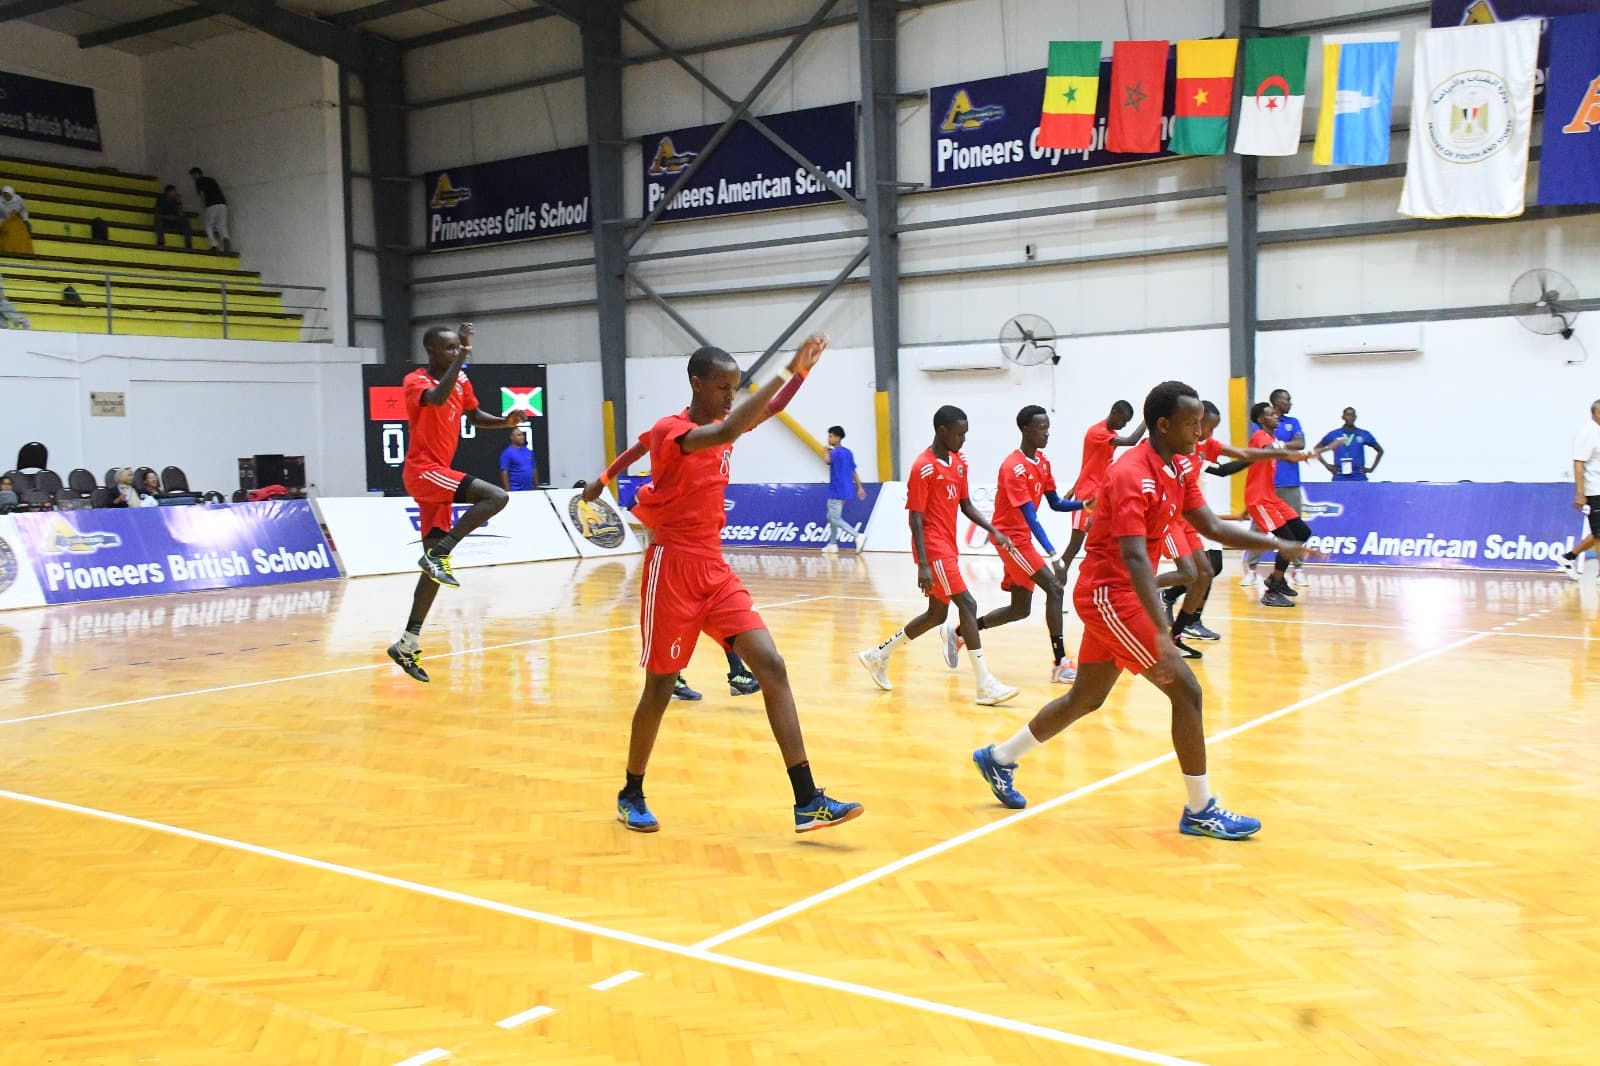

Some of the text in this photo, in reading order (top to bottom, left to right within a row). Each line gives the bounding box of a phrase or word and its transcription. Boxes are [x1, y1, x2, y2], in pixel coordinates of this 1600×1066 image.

[937, 138, 1024, 172] Pioneers
[717, 173, 791, 205] American
[431, 196, 589, 243] Princesses Girls School
[758, 521, 799, 542] Girls
[1360, 531, 1478, 559] American
[1483, 533, 1575, 561] School
[45, 561, 165, 592] Pioneers
[167, 550, 250, 581] British
[251, 544, 330, 575] School
[670, 637, 681, 660] 6
